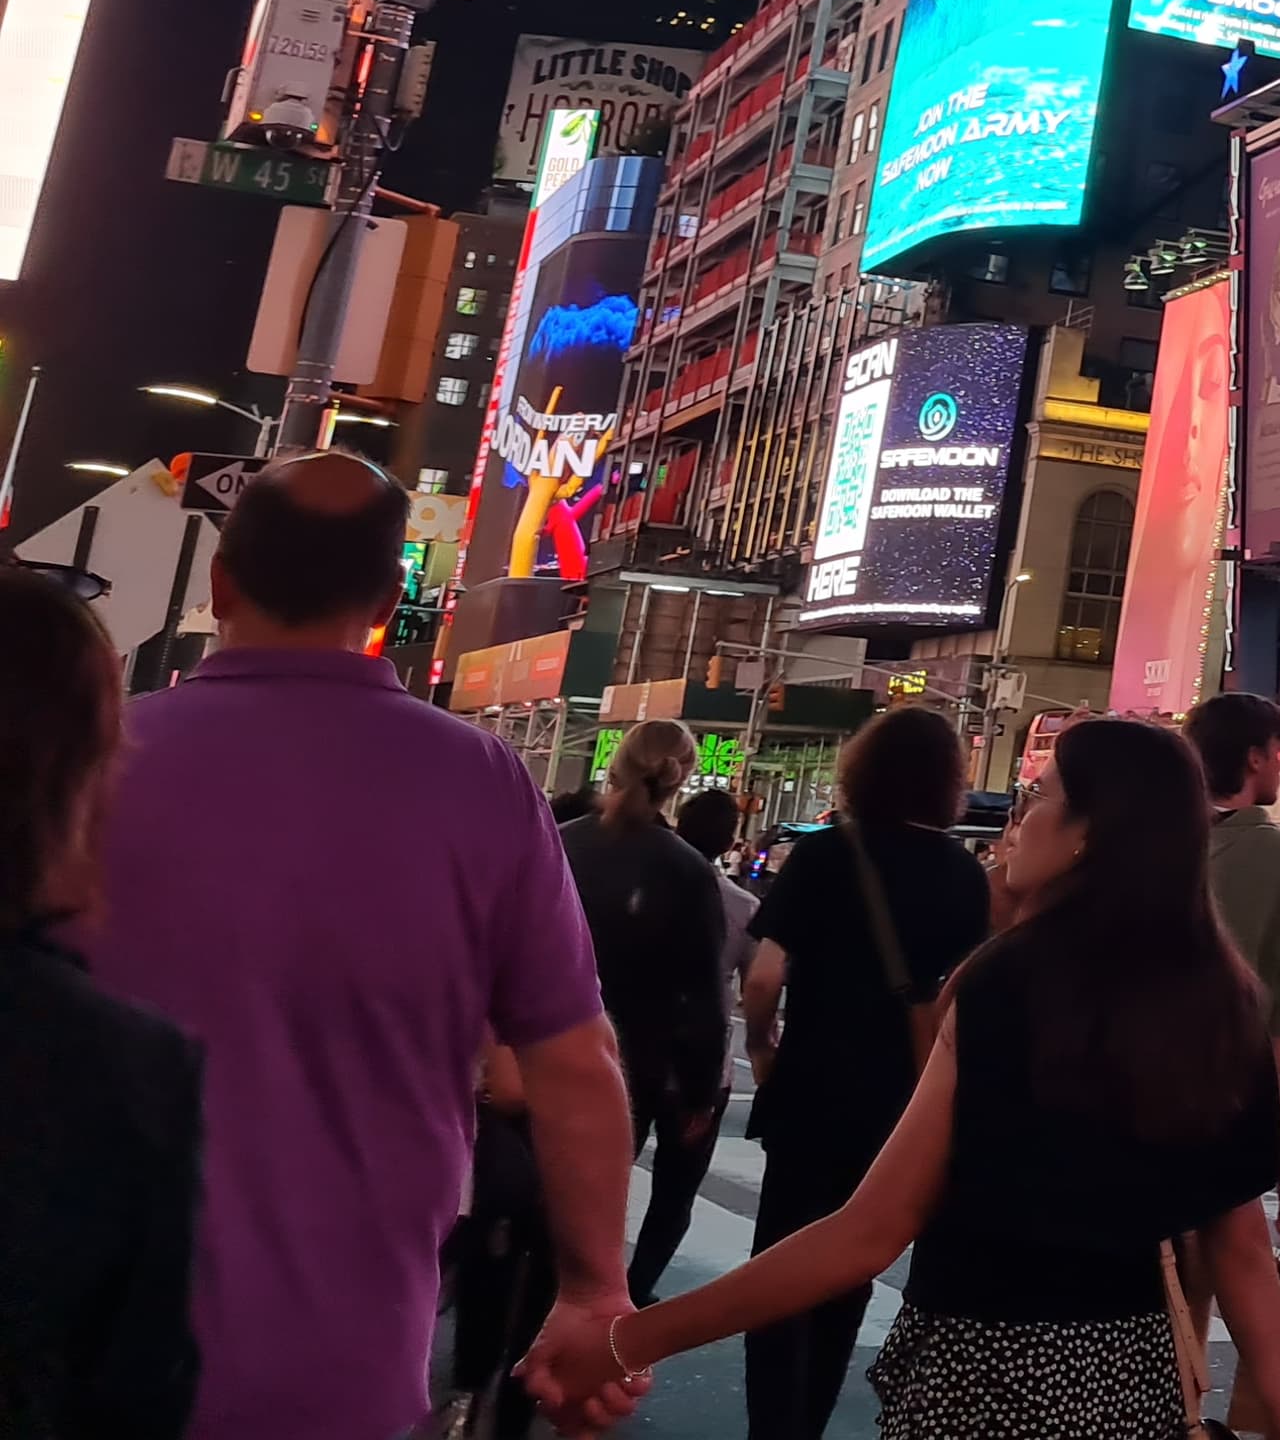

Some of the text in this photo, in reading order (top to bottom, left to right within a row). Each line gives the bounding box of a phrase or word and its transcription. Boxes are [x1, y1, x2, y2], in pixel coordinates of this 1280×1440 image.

[268, 34, 329, 62] 726159
[532, 48, 693, 99] LITTLE SHOP
[946, 82, 991, 116] THE
[880, 111, 1072, 188] SAFEMOON ARMY
[211, 148, 241, 184] W
[253, 160, 293, 192] 45
[544, 172, 576, 189] PEA
[917, 156, 953, 192] NOW
[844, 338, 899, 392] SCAN
[491, 414, 599, 478] JORDAN
[880, 447, 999, 468] SAFEMOON
[1072, 444, 1105, 463] THE
[215, 472, 252, 495] ON
[881, 487, 984, 503] DOWNLOAD THE
[871, 504, 996, 520] SAFEMOON WALLET
[806, 556, 861, 602] HERE
